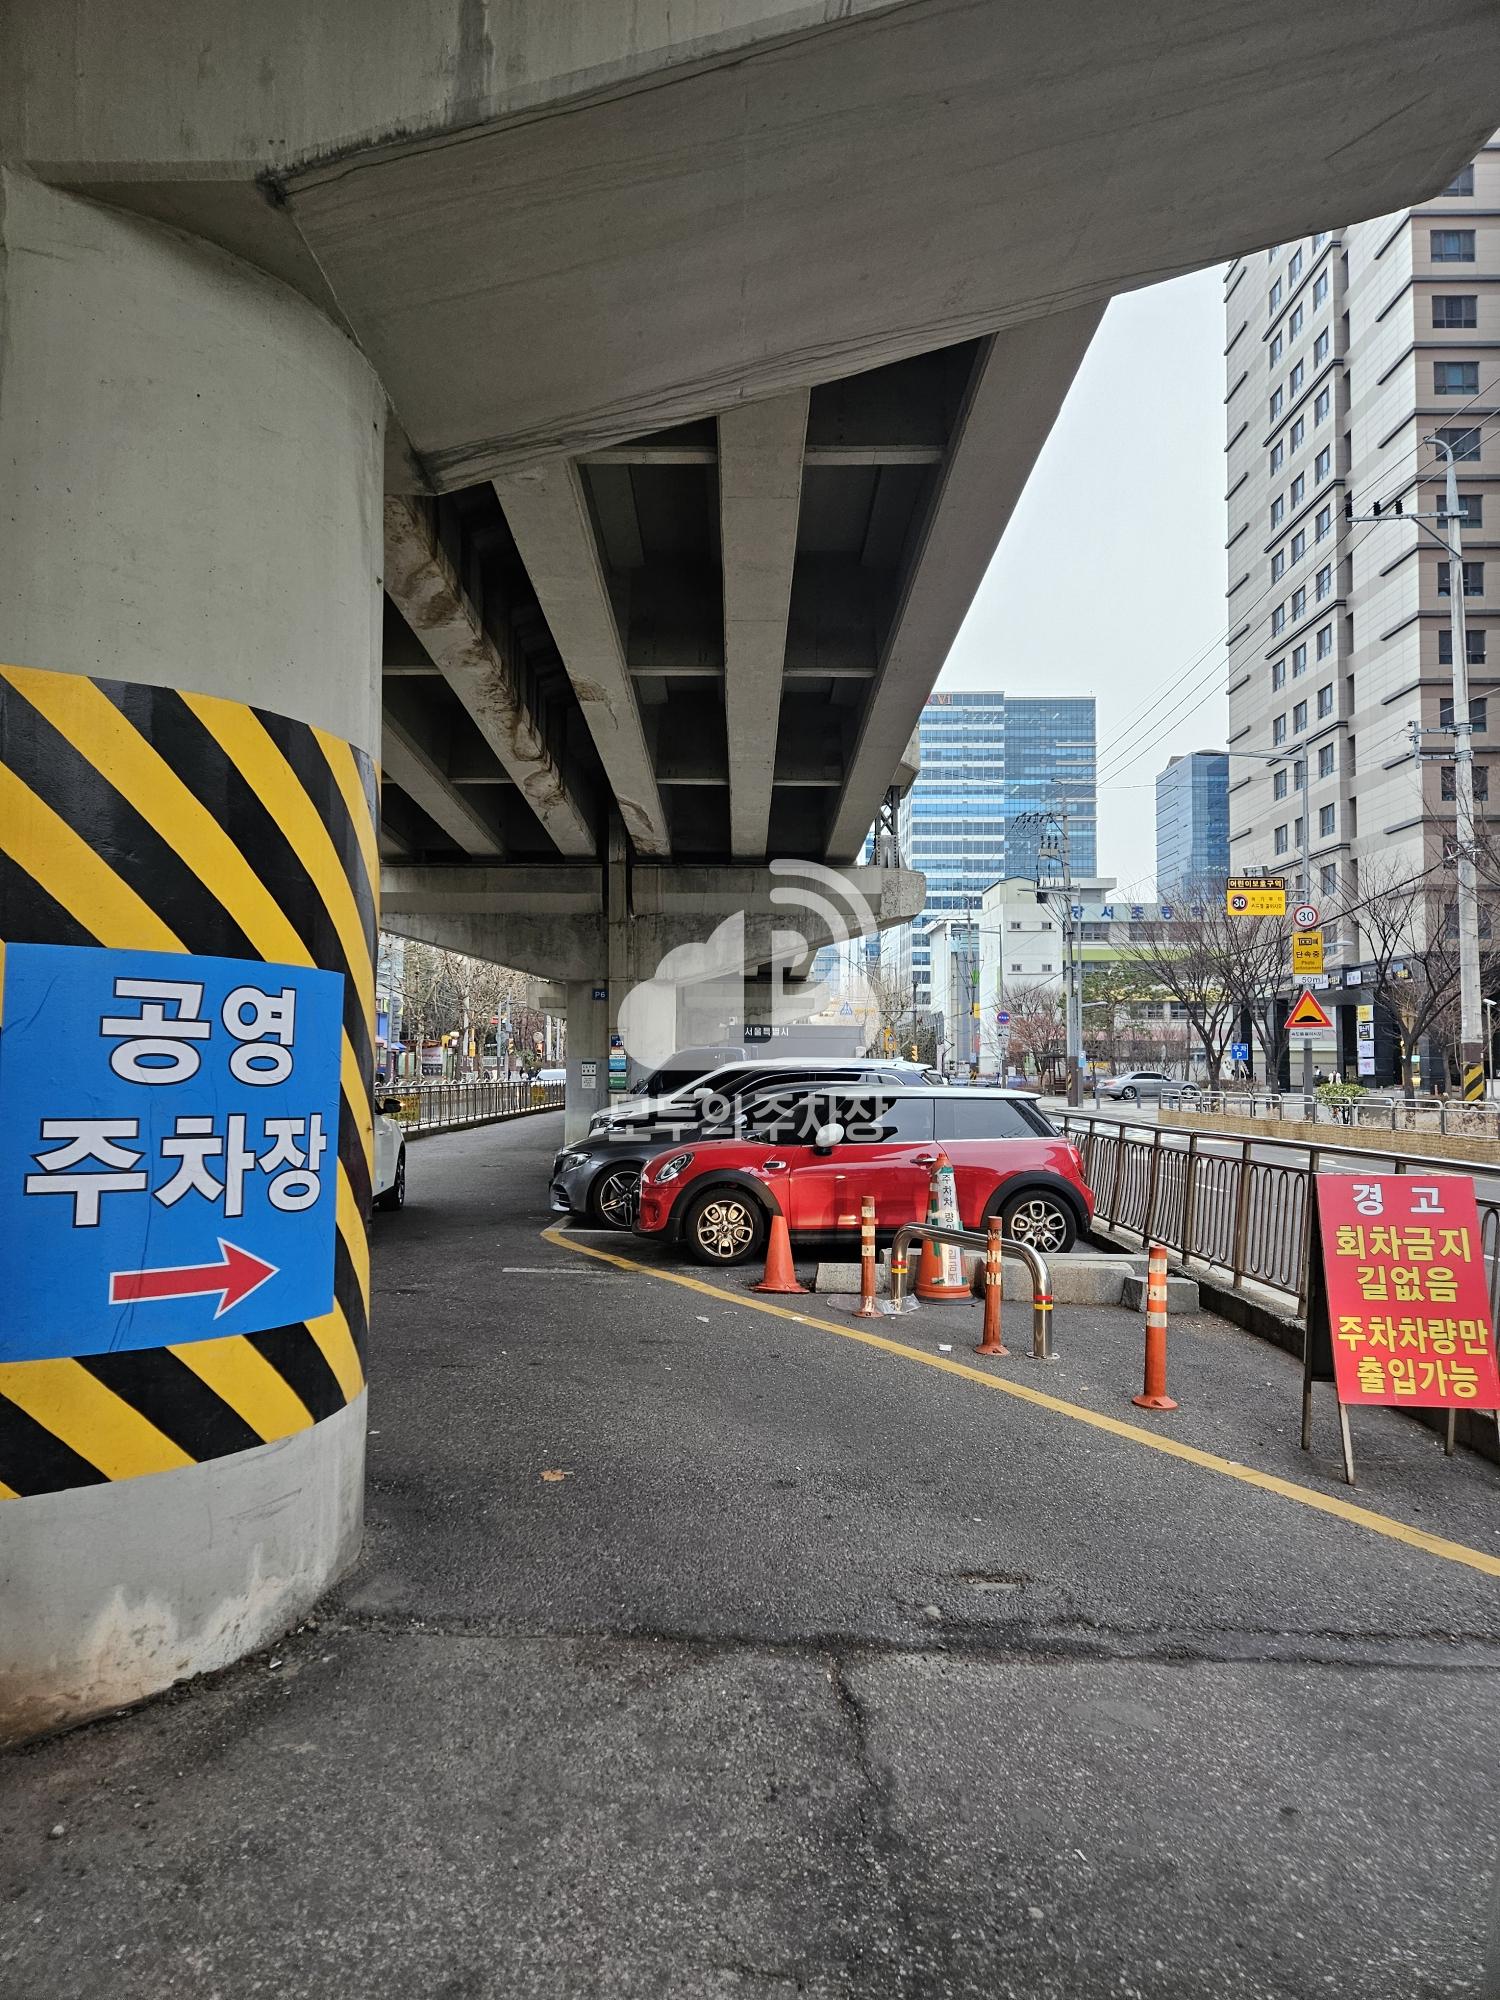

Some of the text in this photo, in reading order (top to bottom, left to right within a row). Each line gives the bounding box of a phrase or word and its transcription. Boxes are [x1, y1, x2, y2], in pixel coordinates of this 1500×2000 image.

[1230, 880, 1282, 888] 어린이보호구역
[1233, 898, 1246, 908] 30
[1299, 911, 1314, 922] 30
[1296, 950, 1320, 959] 단속중
[1302, 976, 1321, 984] 50m
[99, 976, 297, 1087] 공영
[744, 1026, 789, 1037] 서울특별시
[1236, 1051, 1243, 1059] P
[23, 1112, 328, 1228] 주차장
[1335, 1224, 1472, 1263] 회차금지
[1356, 1265, 1459, 1303] 길없음
[1337, 1315, 1489, 1355] 주차차량만
[1356, 1356, 1479, 1398] 출입가능
